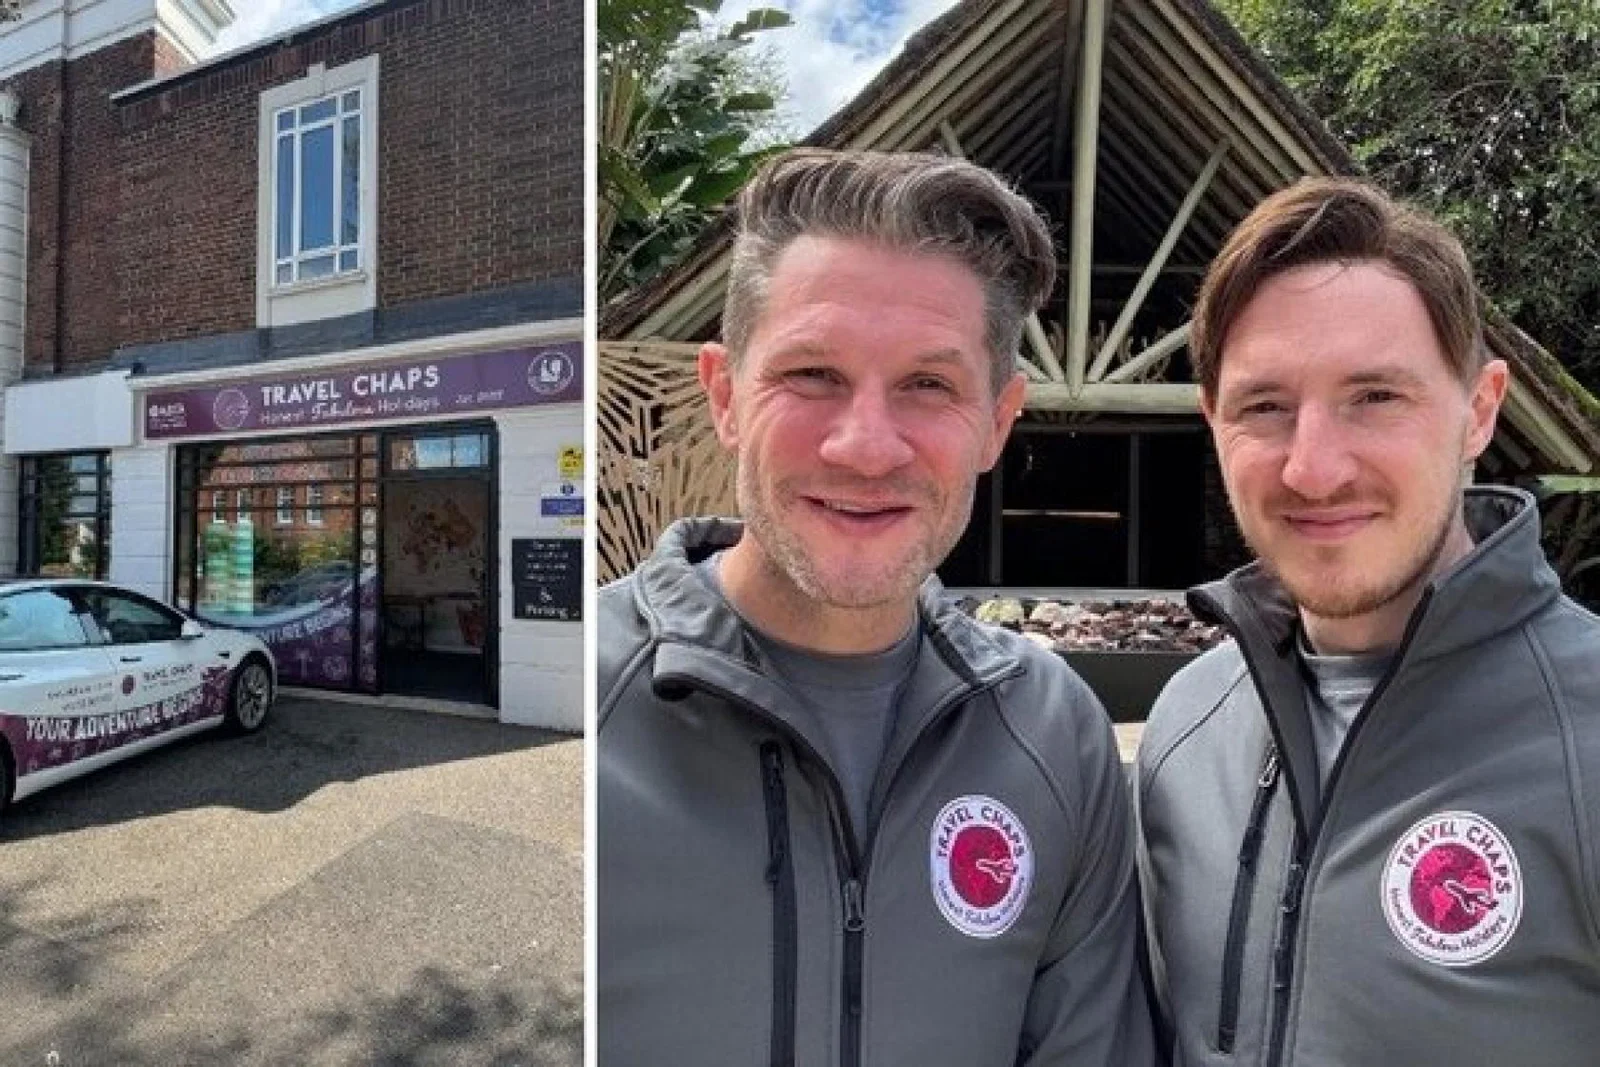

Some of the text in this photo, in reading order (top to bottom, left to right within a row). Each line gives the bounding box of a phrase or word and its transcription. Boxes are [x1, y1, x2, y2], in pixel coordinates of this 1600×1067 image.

[261, 377, 341, 406] TRAVEL
[352, 364, 440, 396] CHAPS
[26, 717, 72, 741] YOUR
[937, 805, 1025, 858] TRAVEL CHAPS
[1397, 820, 1513, 894] TRAVEL CHAPS
